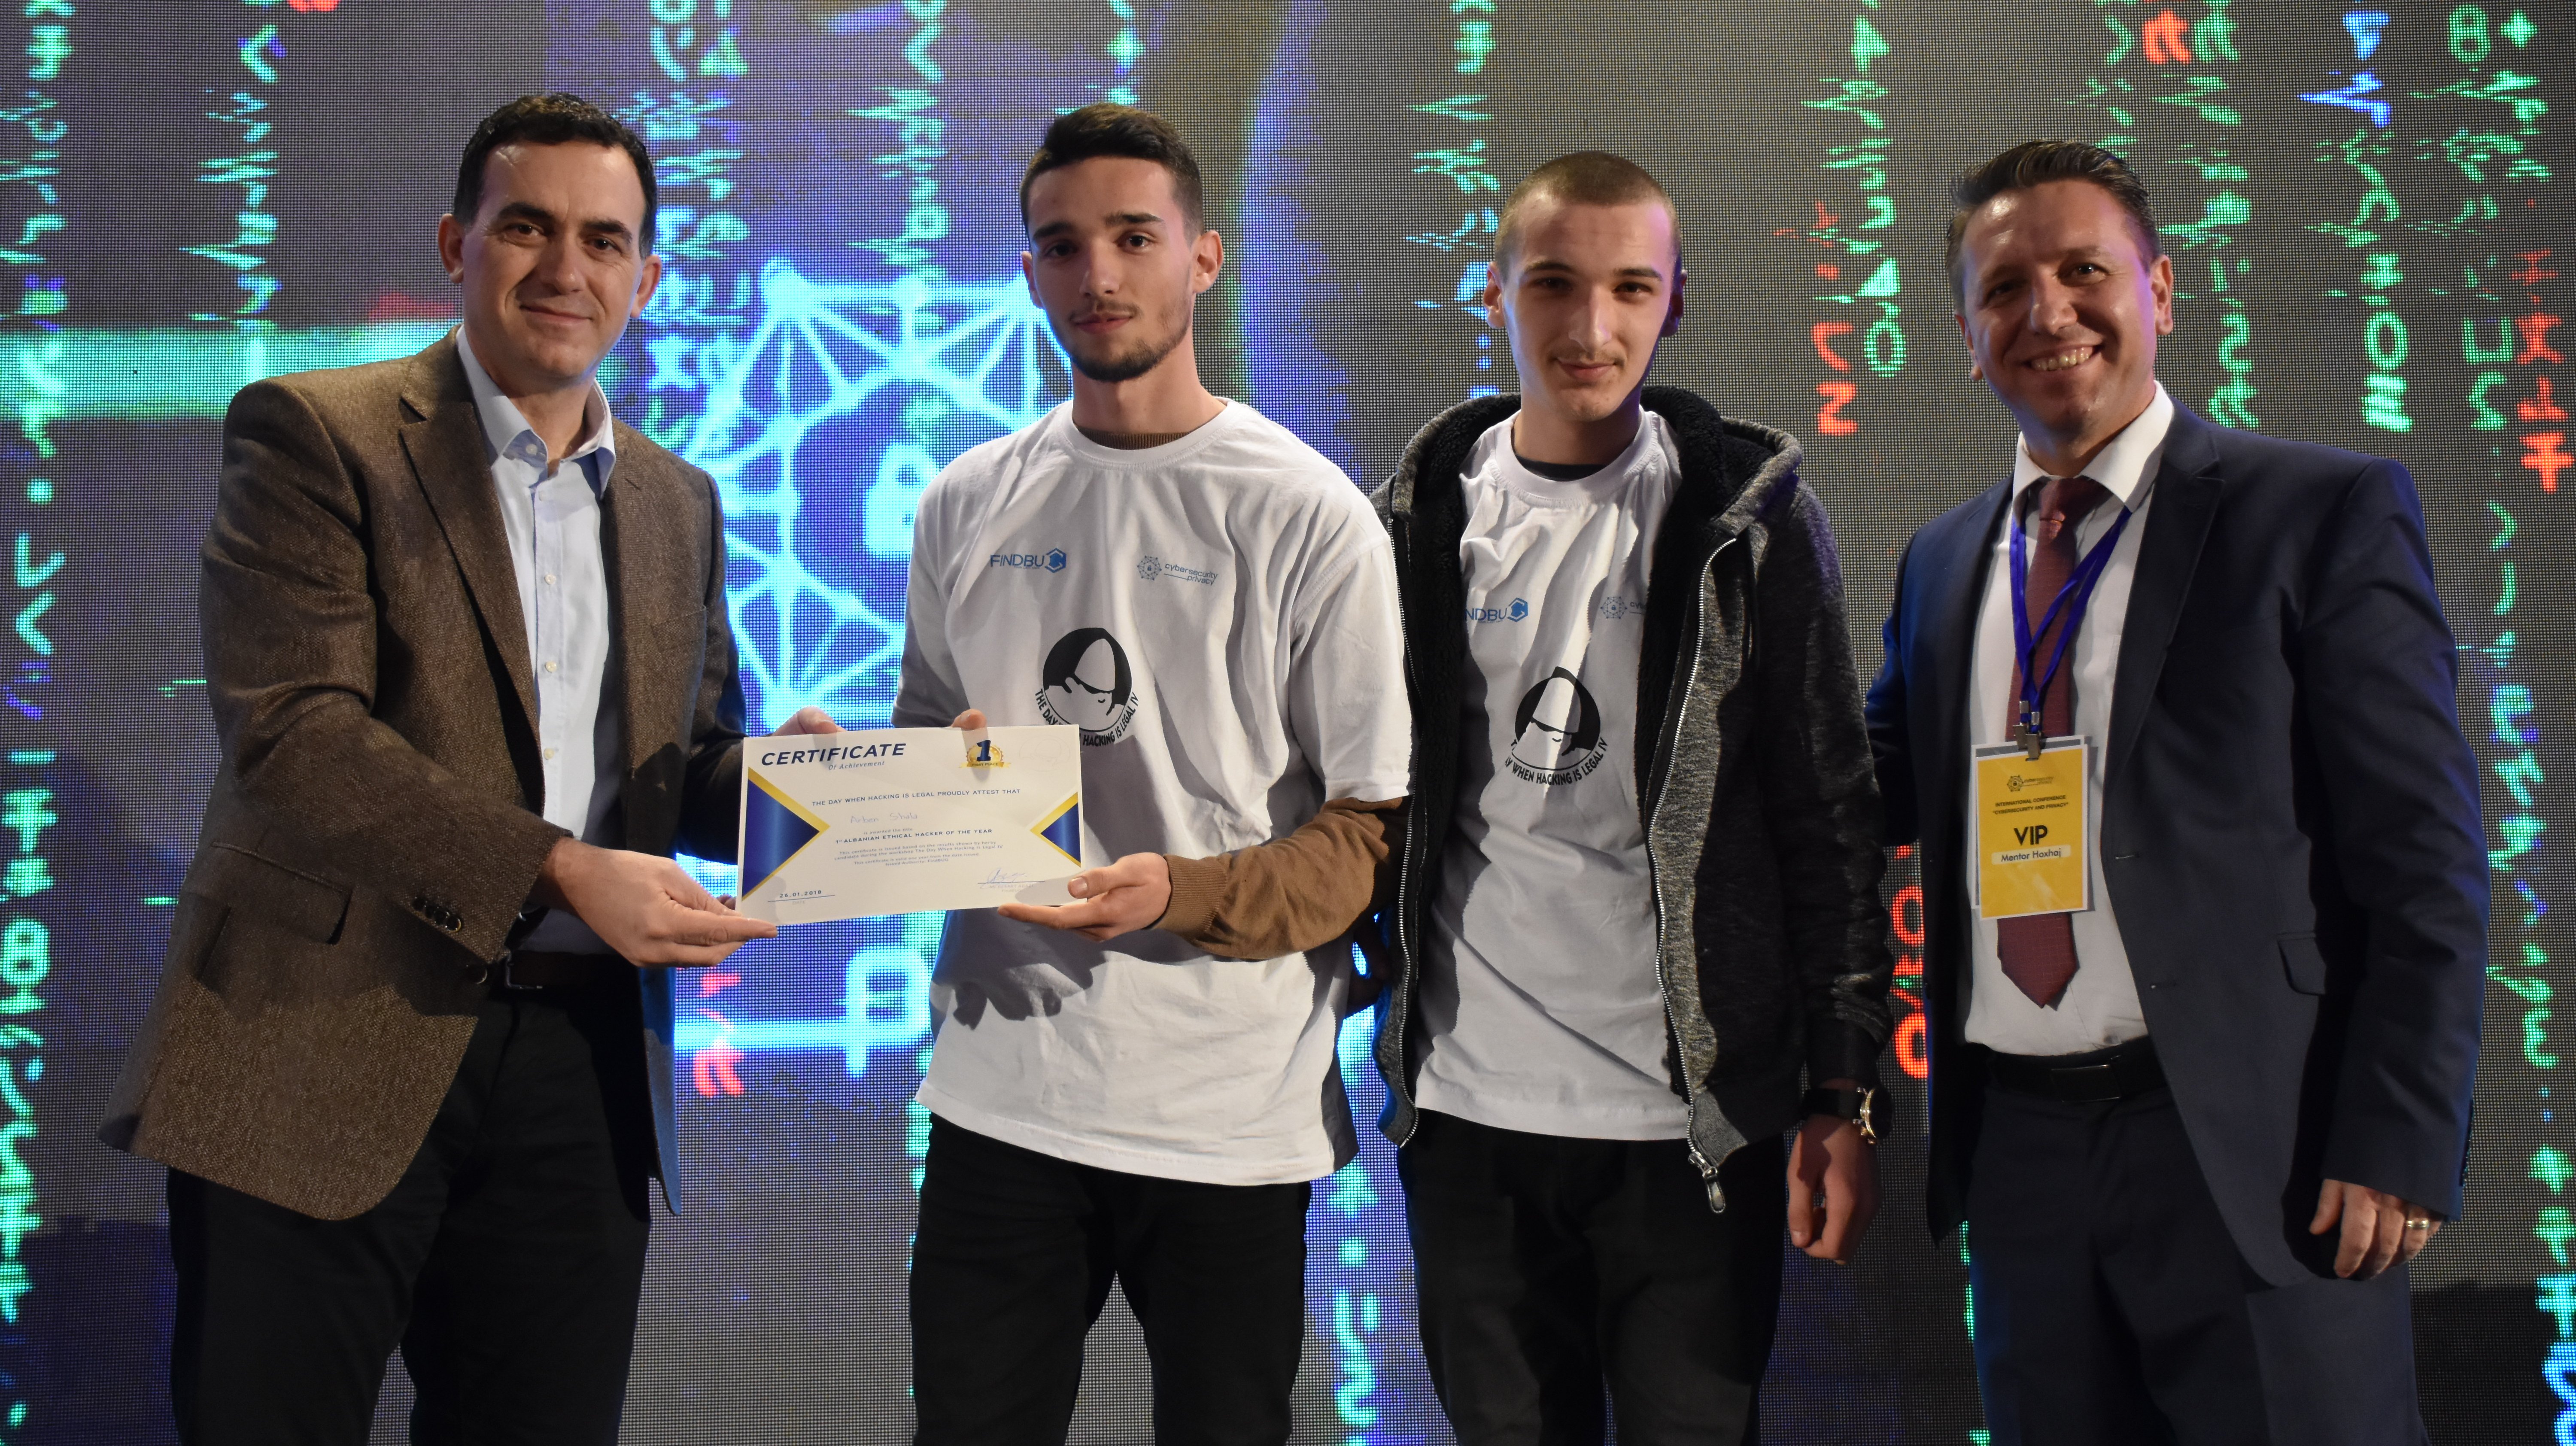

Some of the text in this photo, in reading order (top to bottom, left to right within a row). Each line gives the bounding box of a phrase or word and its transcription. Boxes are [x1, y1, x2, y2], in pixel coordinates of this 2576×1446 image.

[1187, 575, 1215, 586] privacy
[1035, 688, 1047, 711] THE
[1042, 709, 1058, 725] DAY
[1083, 731, 1115, 747] HACKING
[1115, 726, 1122, 738] IS
[1121, 705, 1136, 732] LEGAL
[1130, 692, 1139, 707] IV
[762, 743, 906, 766] CERTIFICATE
[977, 740, 991, 762] 1
[839, 761, 885, 769] Achievement
[1512, 762, 1535, 782] WHEN
[1536, 772, 1572, 786] HACKING
[1573, 769, 1582, 781] IS
[1581, 751, 1604, 776] LEGAL
[1598, 737, 1608, 751] IV
[1995, 799, 2032, 807] INTERNATIONAL
[2014, 825, 2048, 846] VIP
[2001, 848, 2061, 862] Mentor Hoxhaj
[780, 890, 822, 898] 26.01.2018
